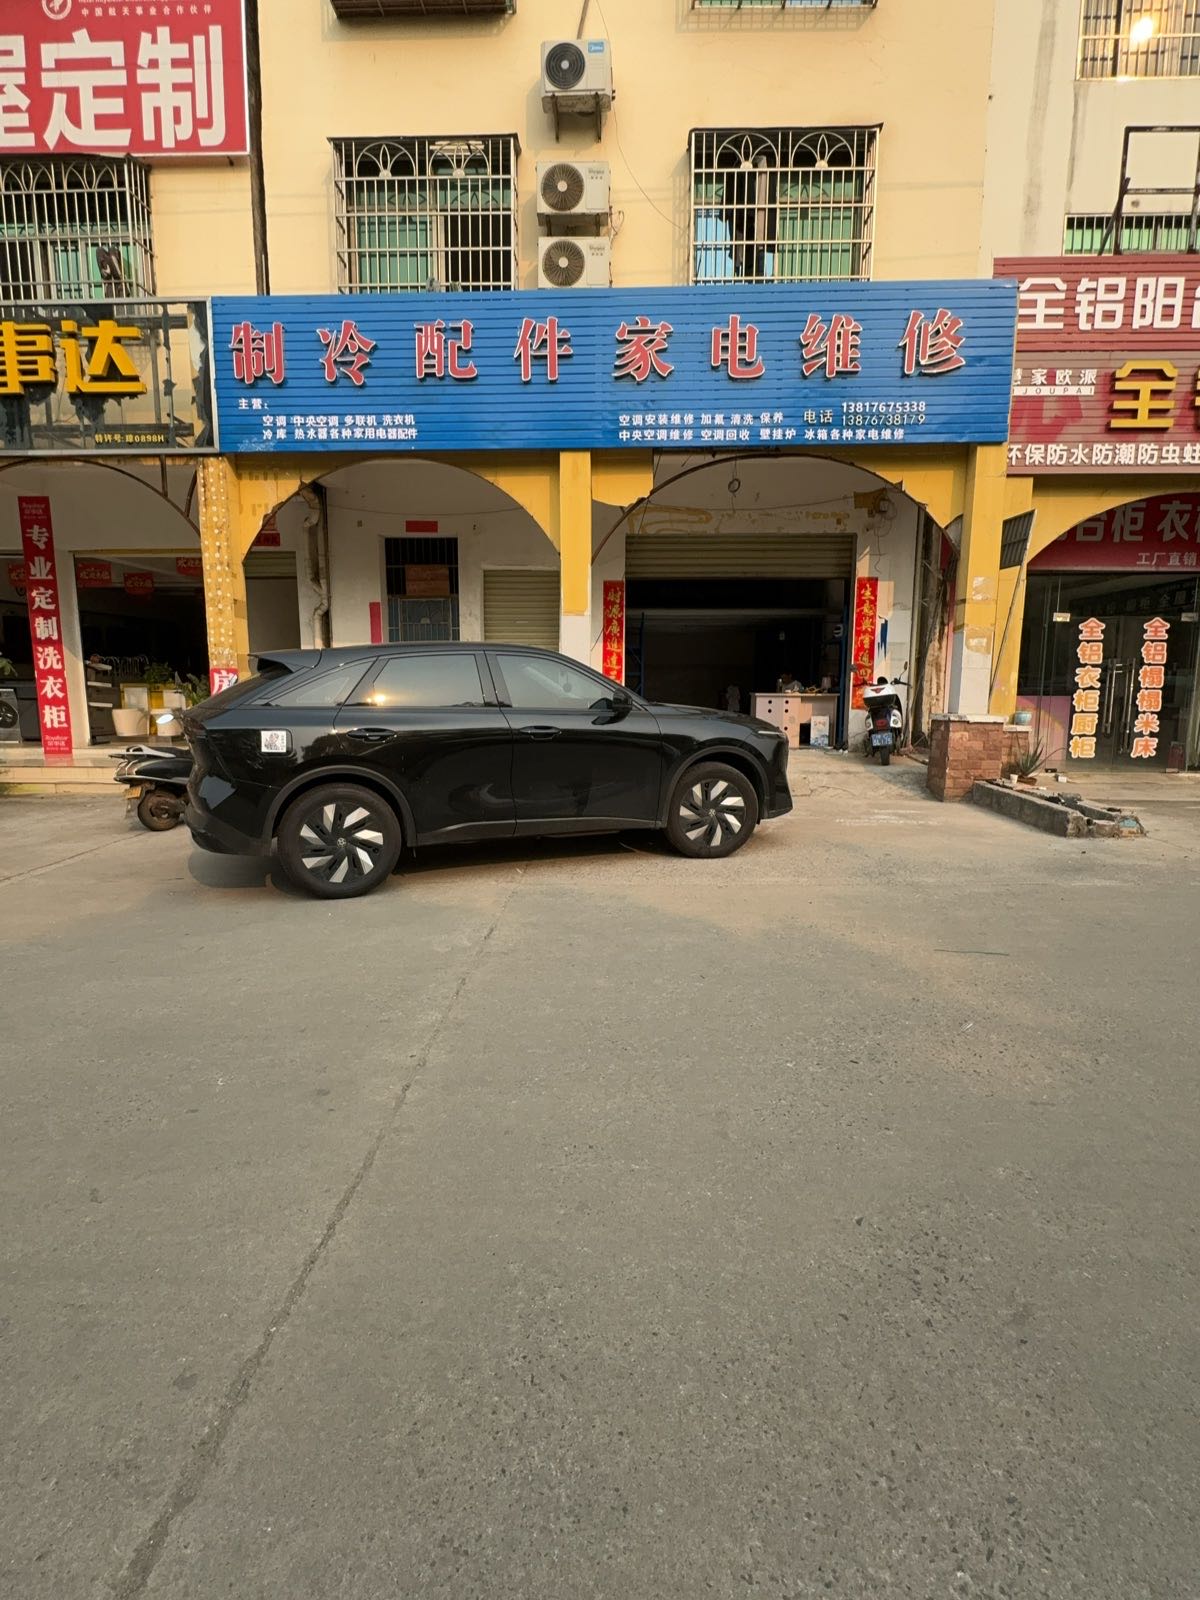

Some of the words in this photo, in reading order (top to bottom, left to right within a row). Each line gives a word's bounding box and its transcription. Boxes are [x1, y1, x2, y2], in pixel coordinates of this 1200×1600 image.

[1017, 276, 1200, 331] 全铝阳
[229, 308, 966, 387] 制冷配件家电维修
[1109, 358, 1200, 429] 全
[262, 415, 287, 427] 空调
[293, 415, 339, 427] 中央空调
[344, 415, 377, 426] 多联机
[382, 414, 415, 425] 洗衣机
[618, 413, 695, 426] 空调安装维修
[730, 413, 754, 425] 清洗
[760, 412, 784, 424] 保养
[803, 409, 833, 424] 电话
[841, 401, 926, 413] 13817675338
[841, 413, 926, 426] 13876738179
[262, 428, 287, 440] 冷库
[294, 428, 418, 440] 热水器各种家用电器配件
[618, 429, 693, 442] 中央空调维修
[700, 429, 750, 441] 空调回收
[759, 428, 796, 440] 壁挂炉
[804, 428, 905, 441] 冰箱各种家电维修
[1157, 500, 1200, 544] 衣
[1136, 551, 1197, 566] 工厂直销
[26, 524, 69, 729] 专业定制洗衣柜
[1069, 617, 1106, 759] 全铝衣柜厨柜
[1131, 617, 1170, 759] 全铝榻榻米床
